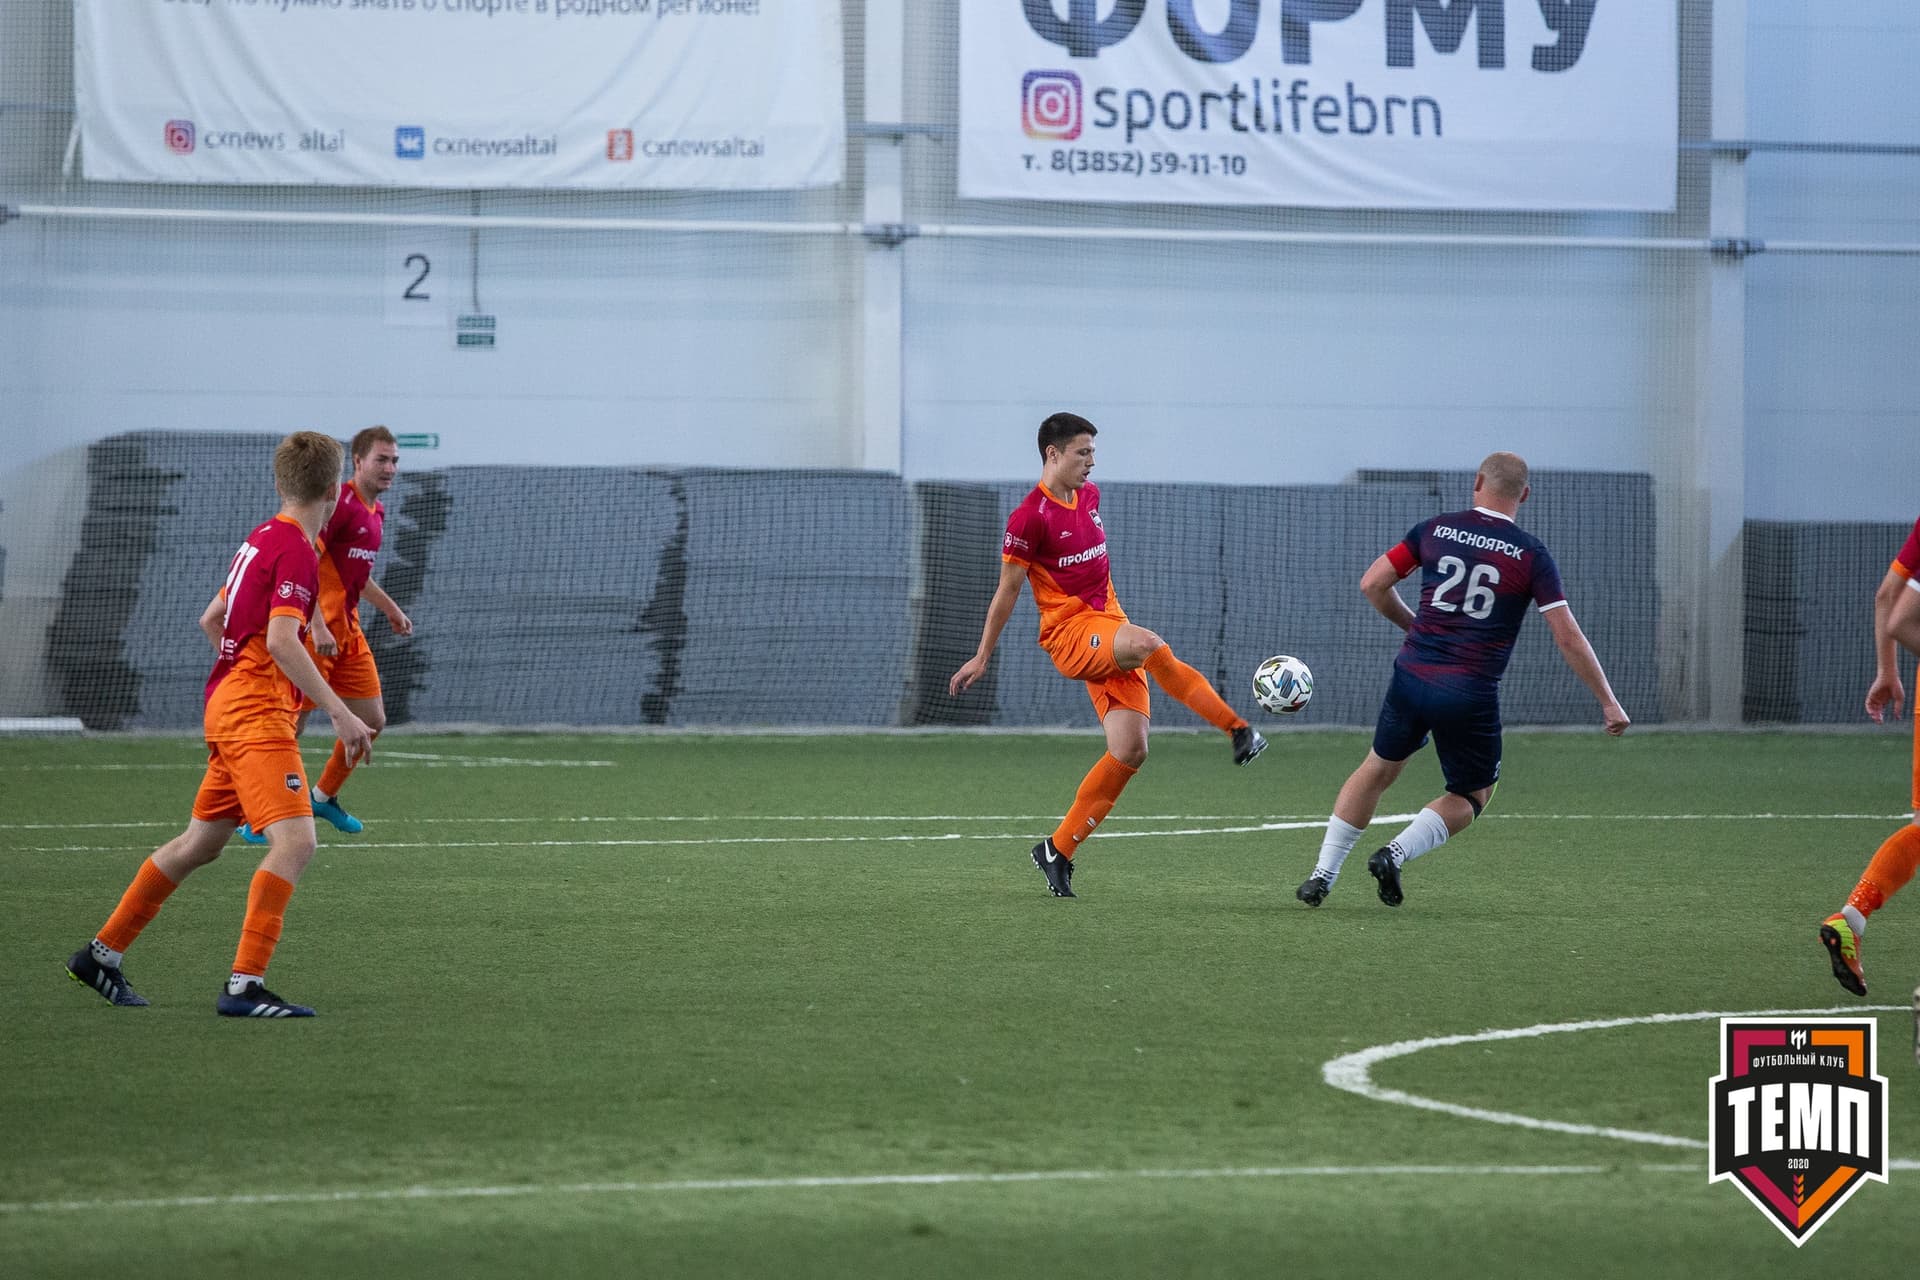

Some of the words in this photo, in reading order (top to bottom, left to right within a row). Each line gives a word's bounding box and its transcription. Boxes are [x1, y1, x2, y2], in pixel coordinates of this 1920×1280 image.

[1093, 77, 1442, 144] sportlifebrn
[432, 134, 558, 156] cxnewsaltai
[642, 136, 765, 158] cxnewsaltai
[1051, 150, 1144, 177] 8(3852)
[1149, 151, 1247, 176] 59-11-10
[403, 253, 431, 300] 2
[1433, 524, 1525, 561] КРАСНОЯРСК
[1431, 555, 1500, 620] 26
